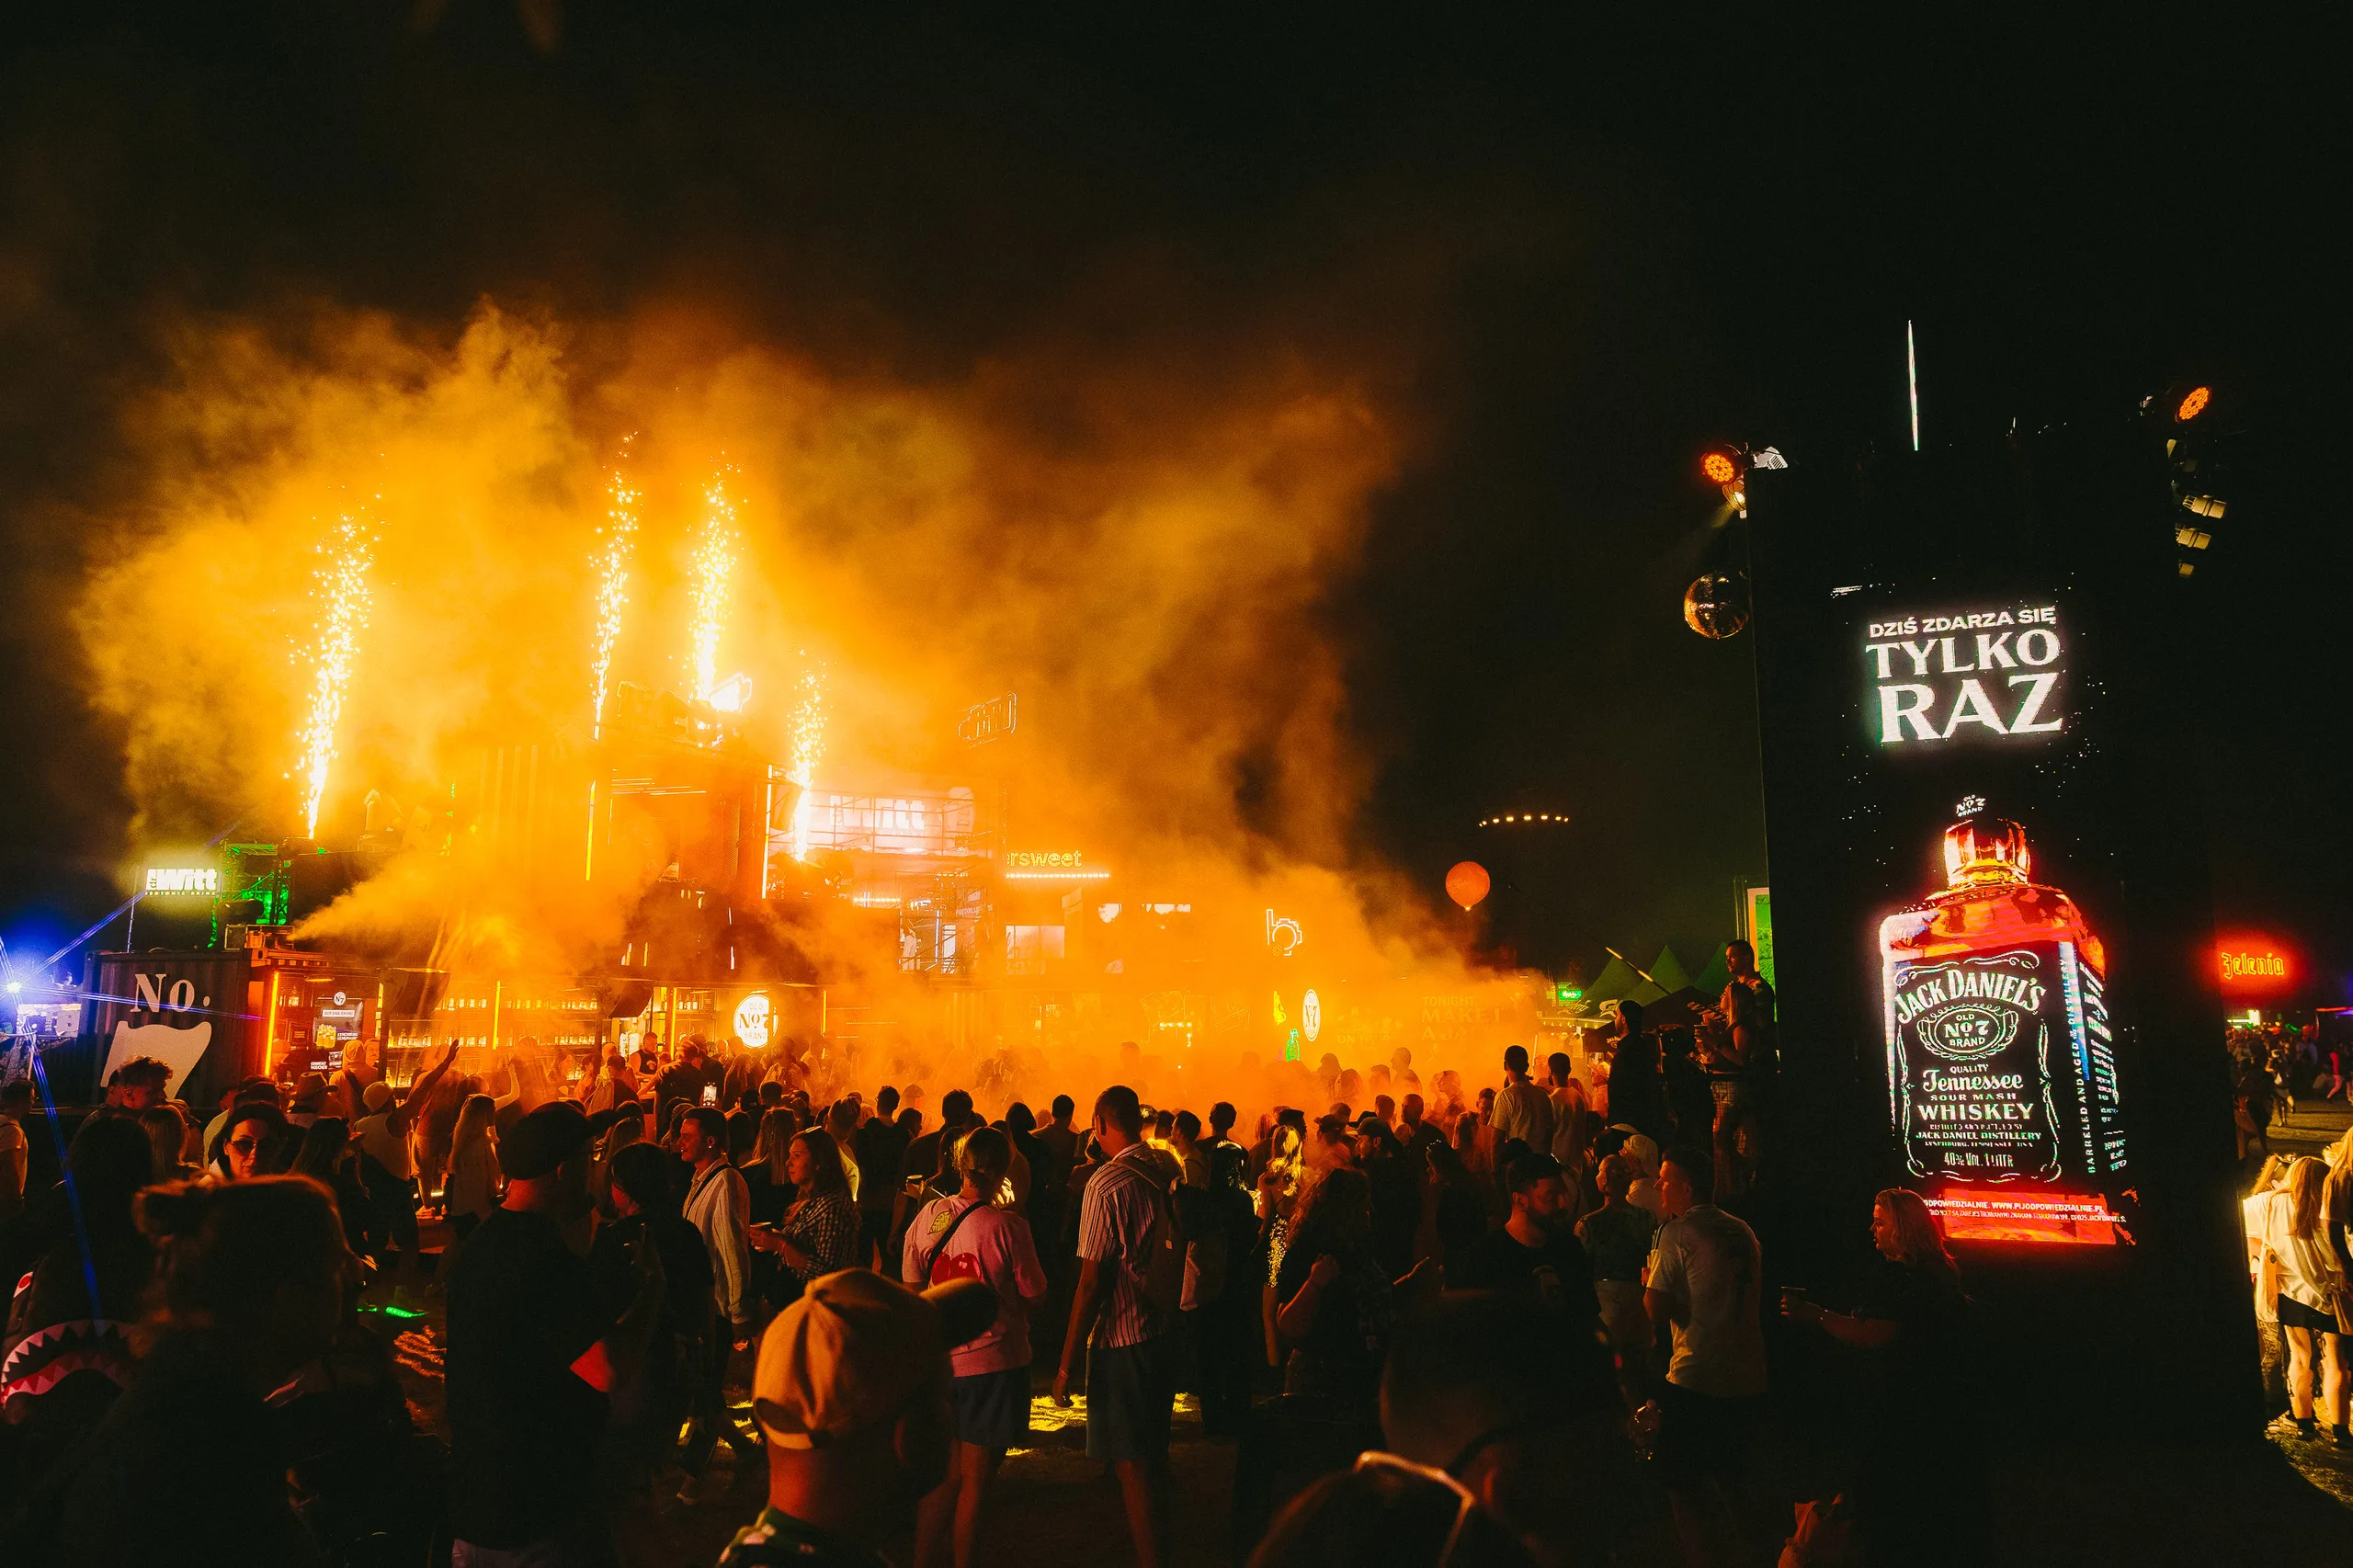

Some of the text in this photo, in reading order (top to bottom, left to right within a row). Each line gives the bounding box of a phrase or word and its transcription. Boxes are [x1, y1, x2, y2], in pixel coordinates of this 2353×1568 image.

[1870, 606, 2057, 638] DZIŚ ZDARZA SIĘ
[1865, 629, 2061, 679] TYLKO
[1877, 672, 2064, 743] RAZ
[1894, 978, 1943, 1024] JACK
[1946, 969, 2047, 1013] DANIEL'S
[1956, 1013, 1975, 1021] OLD
[1949, 1036, 1985, 1048] BRAND
[1949, 1063, 1989, 1074] QUALITY
[2071, 1042, 2084, 1074] AGED
[1922, 1069, 2024, 1092] Tennessee
[2075, 1077, 2087, 1103] AND
[1930, 1092, 2017, 1102] SOUR MASH
[1917, 1103, 2034, 1120] WHISKEY
[1915, 1131, 2041, 1140] JACK DANIEL DISTILLERY
[2079, 1107, 2097, 1174] BARRELED
